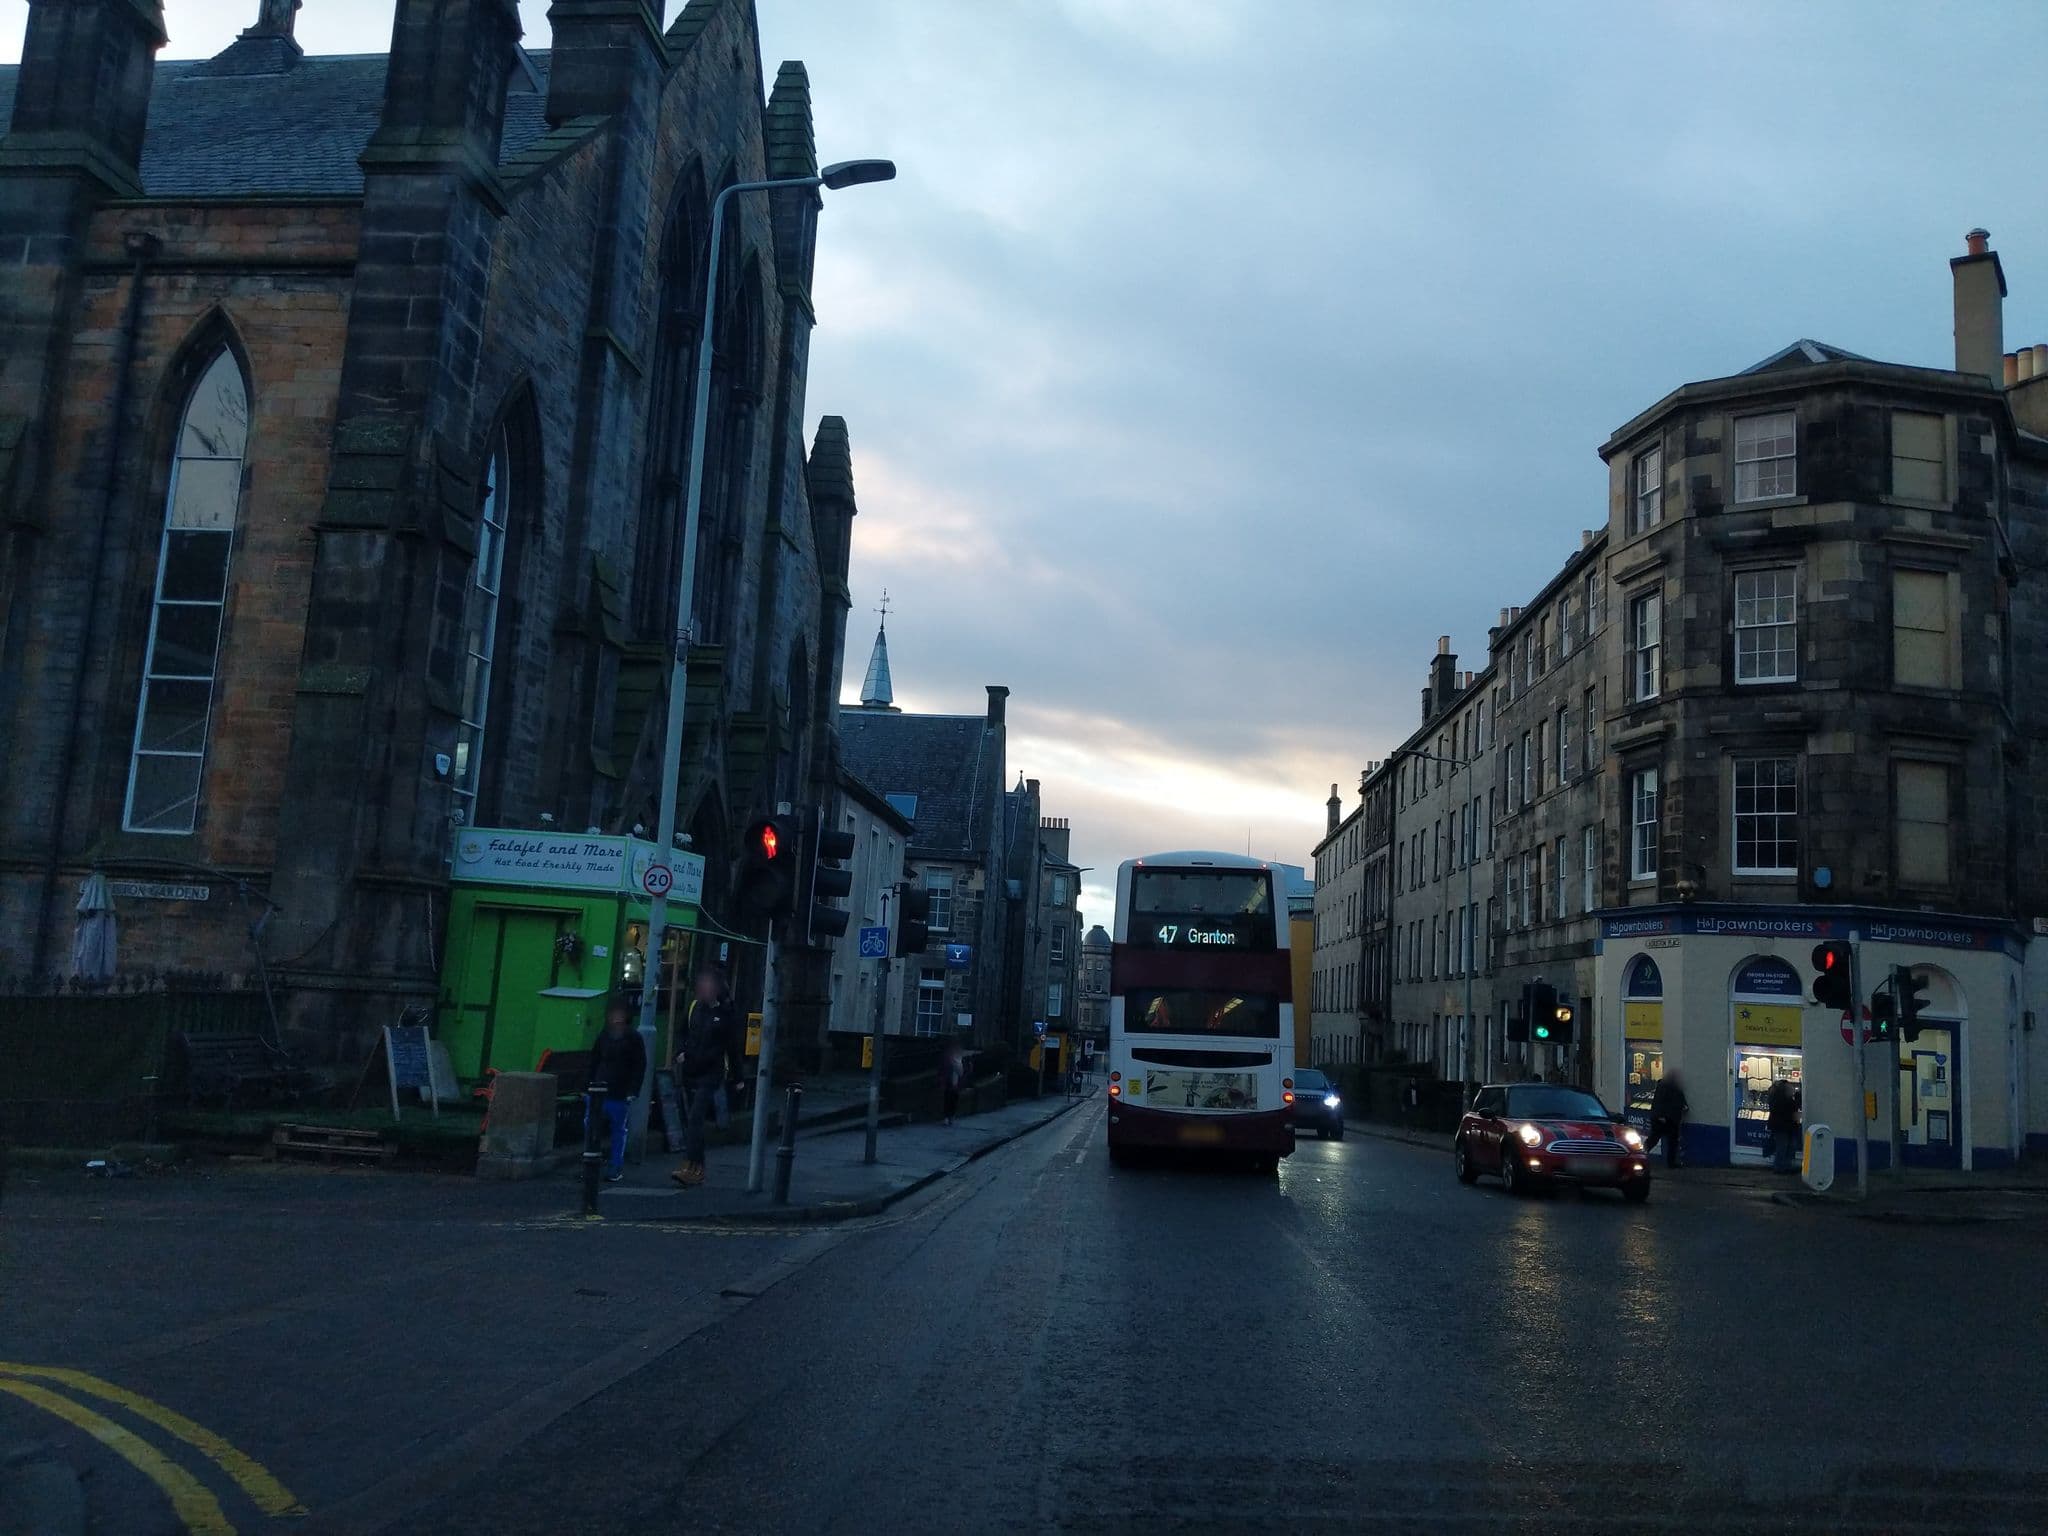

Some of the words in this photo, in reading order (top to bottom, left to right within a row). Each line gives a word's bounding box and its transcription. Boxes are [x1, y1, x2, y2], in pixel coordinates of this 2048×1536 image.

[489, 839, 543, 857] Falafel
[549, 844, 578, 855] and
[584, 844, 623, 857] More
[495, 857, 511, 866] Hot
[515, 858, 539, 868] Food
[543, 860, 582, 873] Freshly
[586, 862, 615, 872] Made
[648, 873, 669, 887] 20
[1718, 919, 1814, 932] pawnbrokers
[1158, 925, 1178, 944] 47
[1188, 928, 1235, 945] Granton
